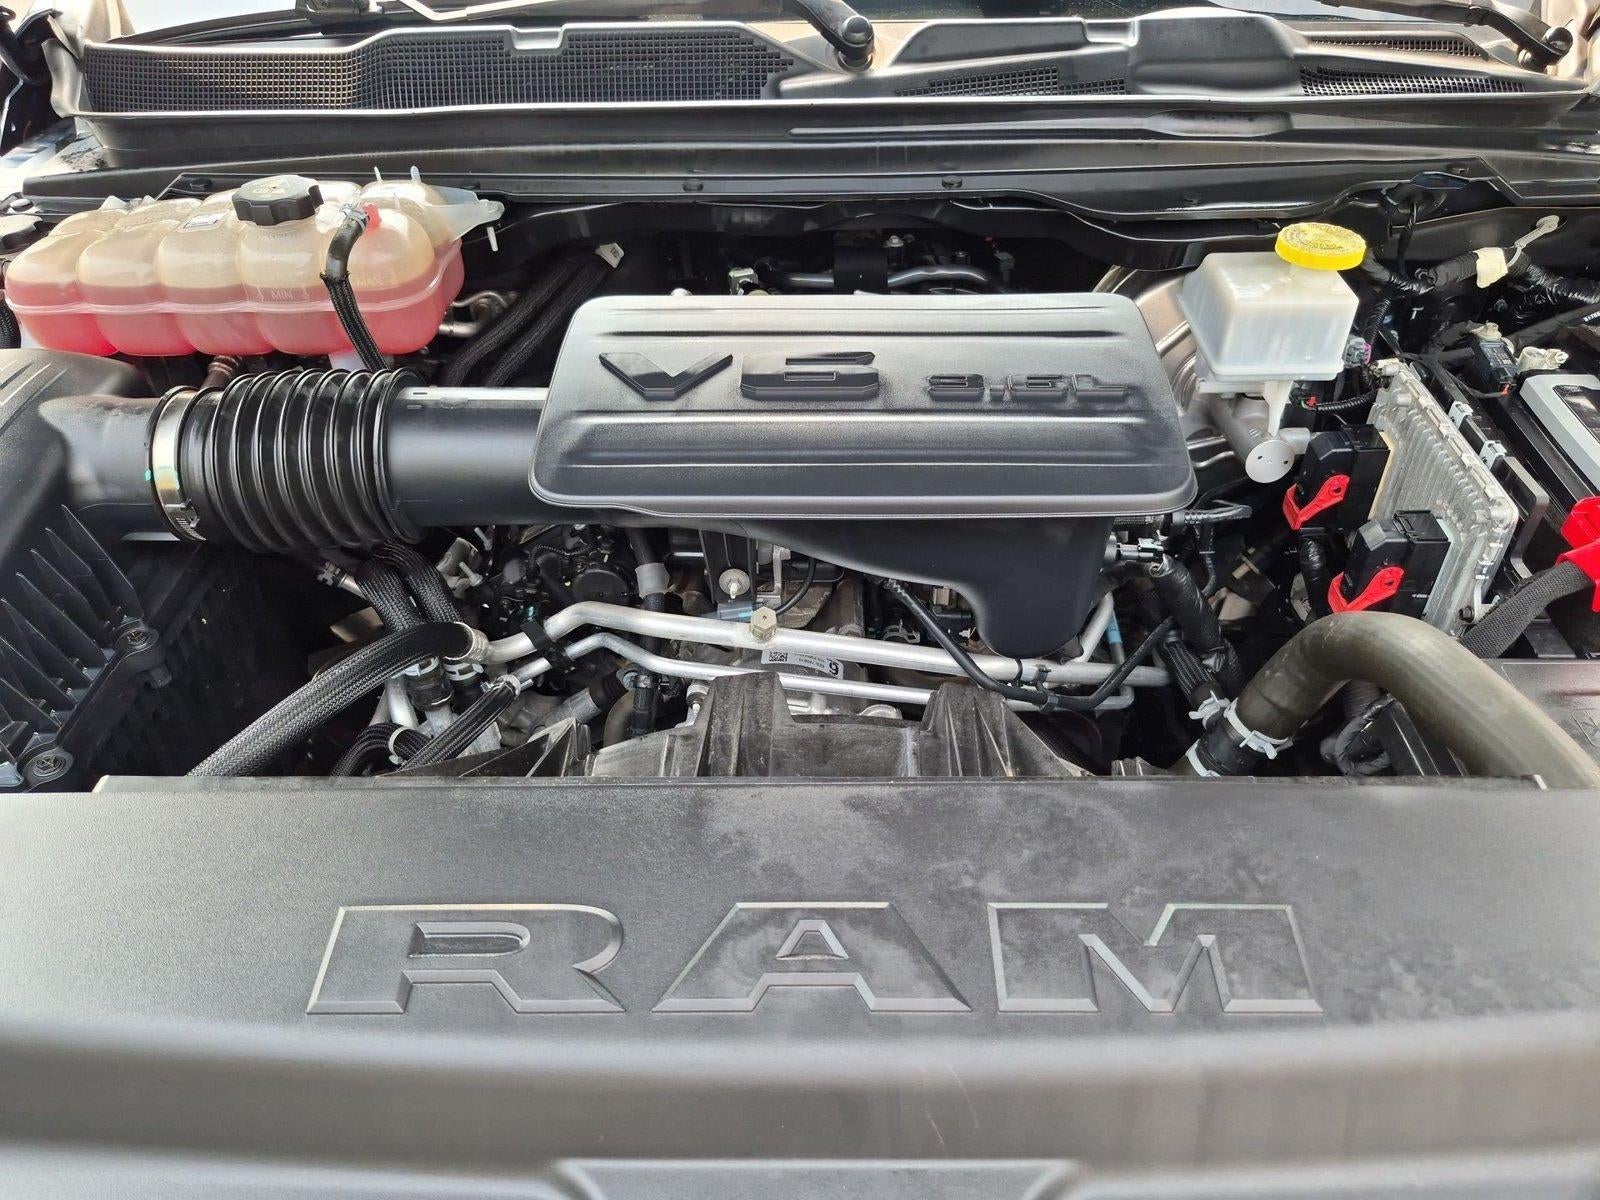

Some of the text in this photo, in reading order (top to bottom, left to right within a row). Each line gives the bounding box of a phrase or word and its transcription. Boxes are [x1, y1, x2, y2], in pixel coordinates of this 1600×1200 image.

[271, 288, 294, 301] MIN
[599, 351, 1128, 402] V6 3.6L
[307, 902, 1323, 1013] RAM
